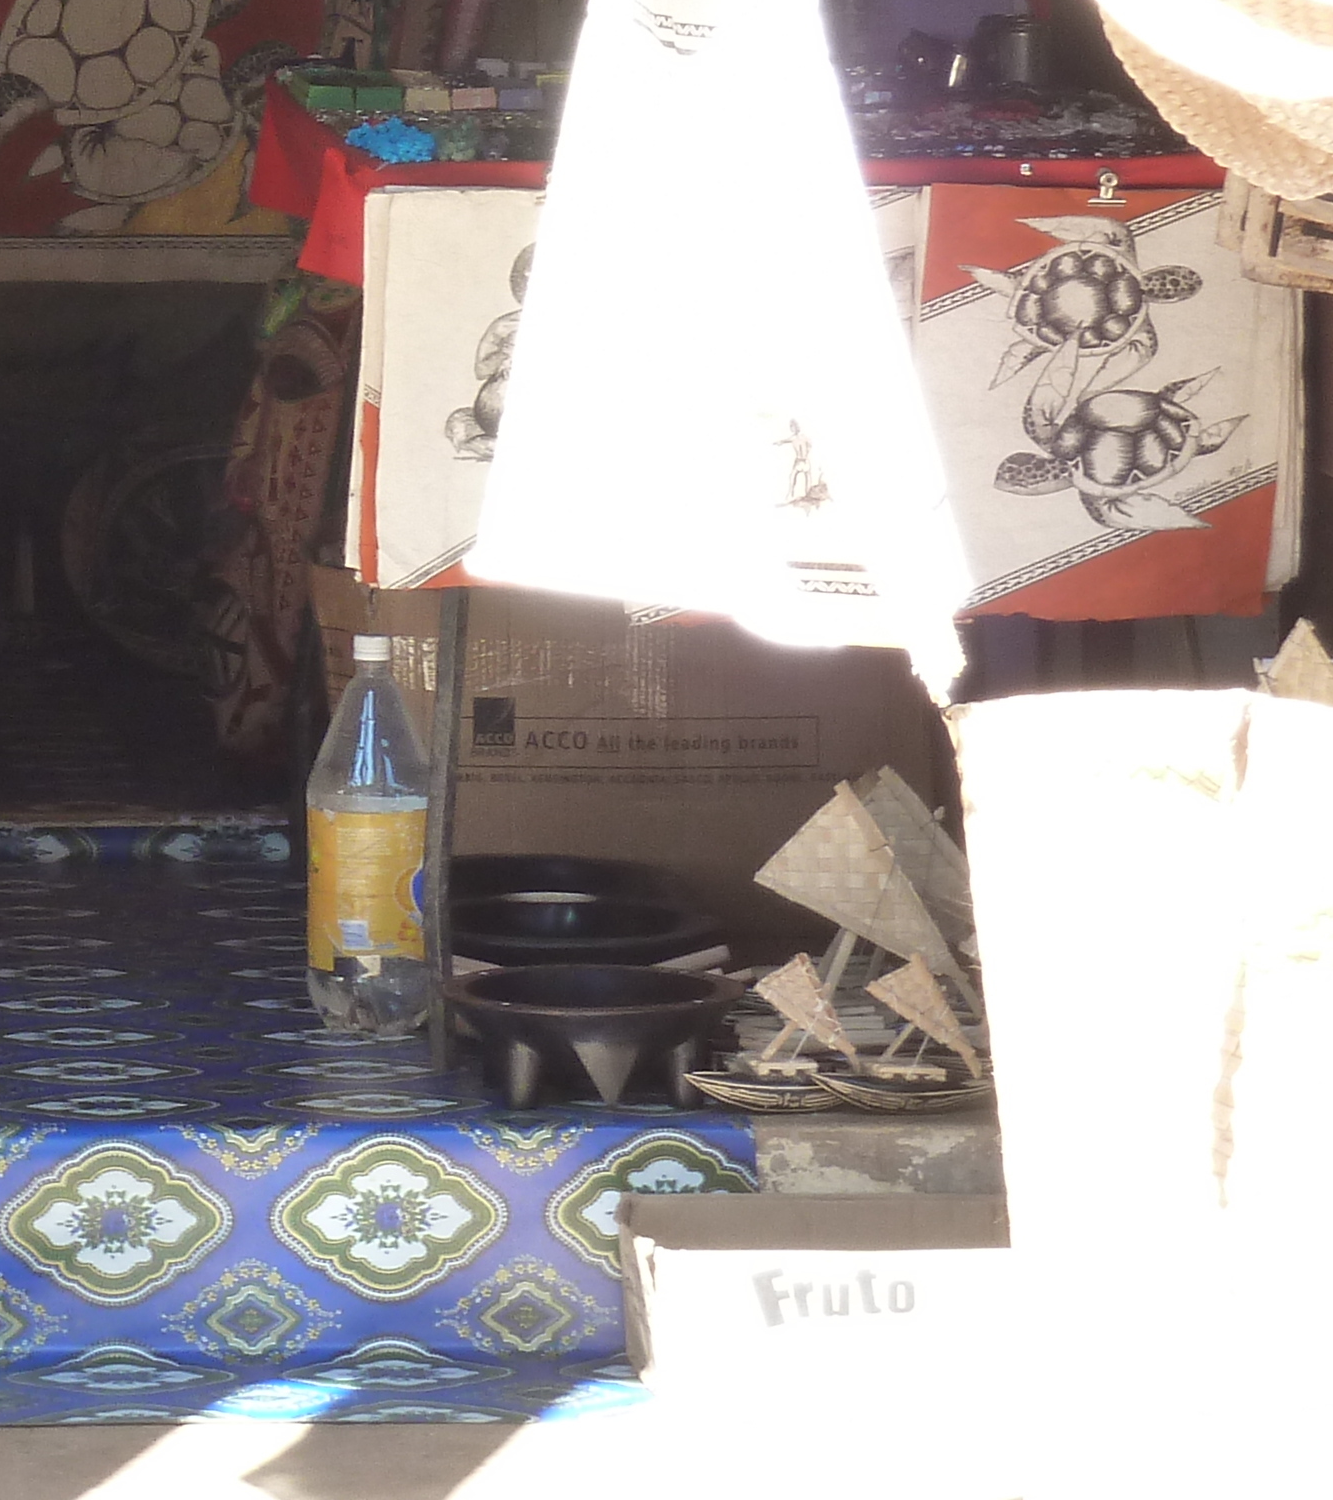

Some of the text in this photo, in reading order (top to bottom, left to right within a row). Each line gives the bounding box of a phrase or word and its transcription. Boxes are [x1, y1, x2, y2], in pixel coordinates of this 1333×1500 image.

[524, 730, 588, 750] ACCO
[628, 733, 657, 751] the
[664, 734, 731, 754] leading
[737, 735, 799, 751] brands
[751, 1267, 916, 1328] Fruto
